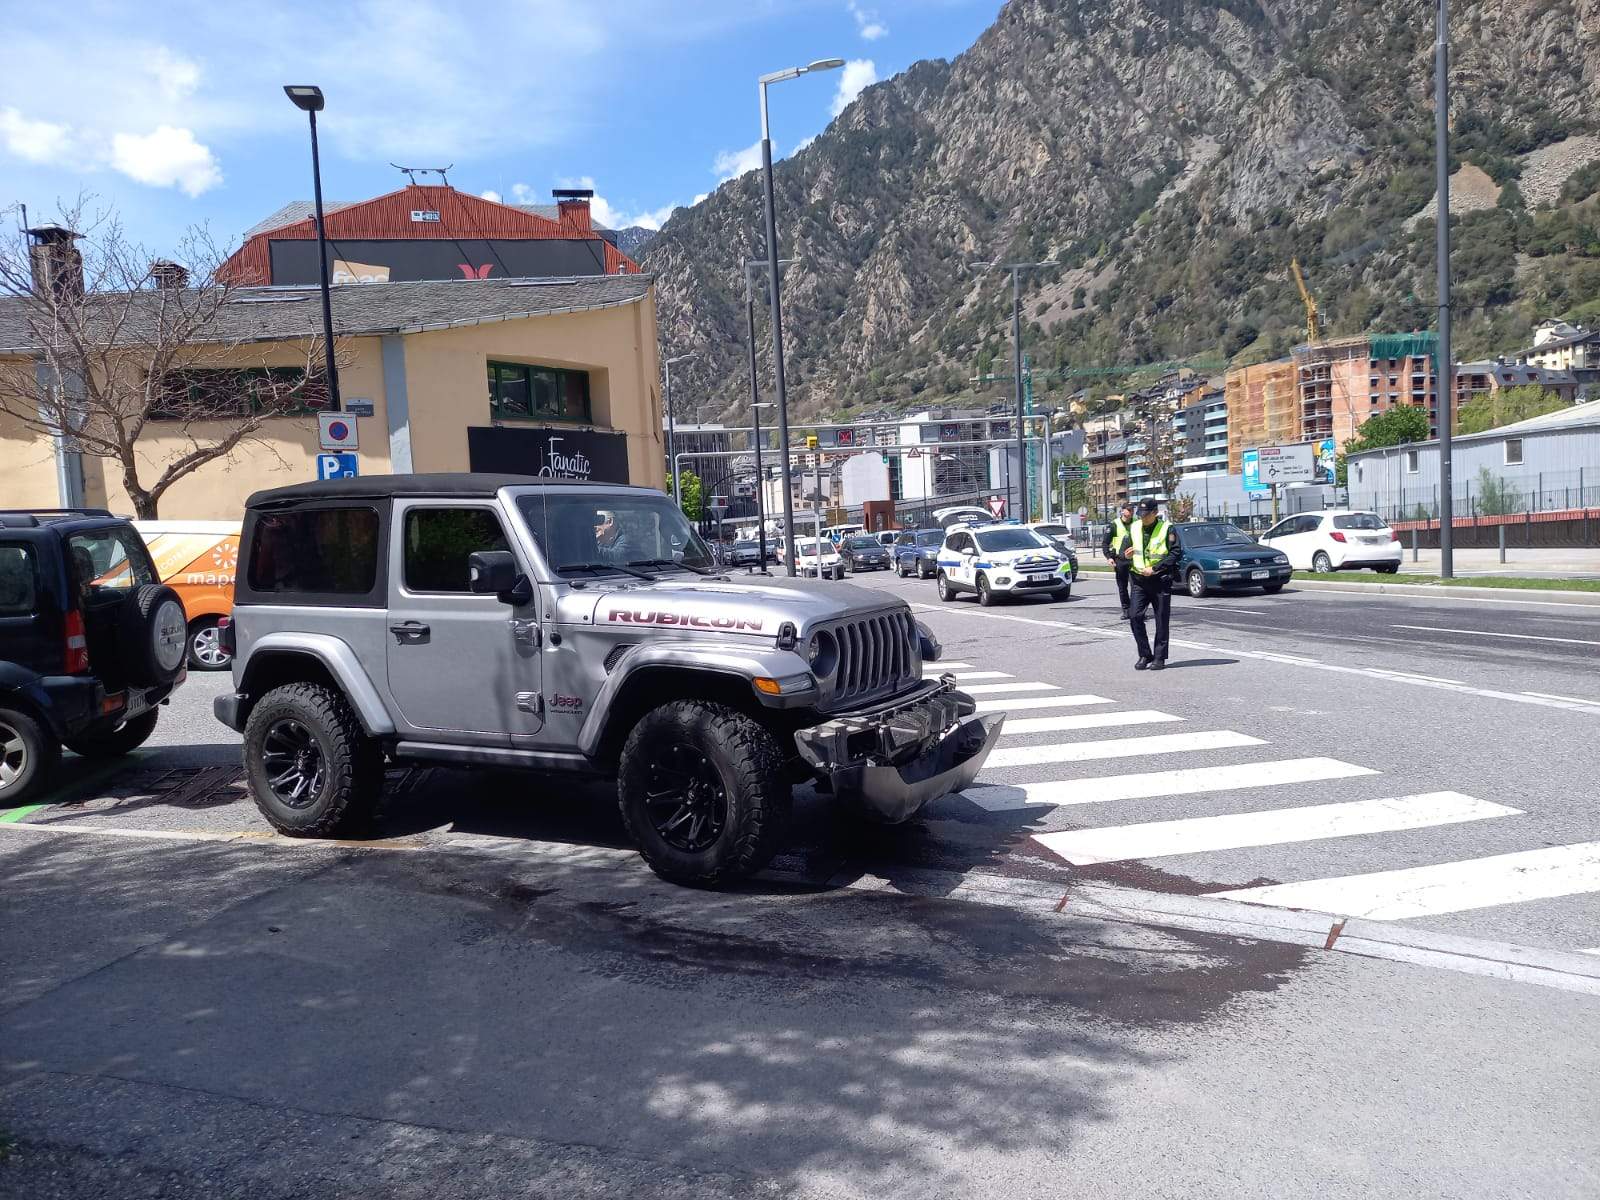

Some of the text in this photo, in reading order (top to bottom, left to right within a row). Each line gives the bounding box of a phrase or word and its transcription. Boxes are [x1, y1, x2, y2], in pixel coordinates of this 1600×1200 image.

[548, 436, 591, 474] Fanatic
[322, 456, 340, 480] P
[608, 609, 763, 630] RUBICON
[549, 693, 583, 710] Jeep
